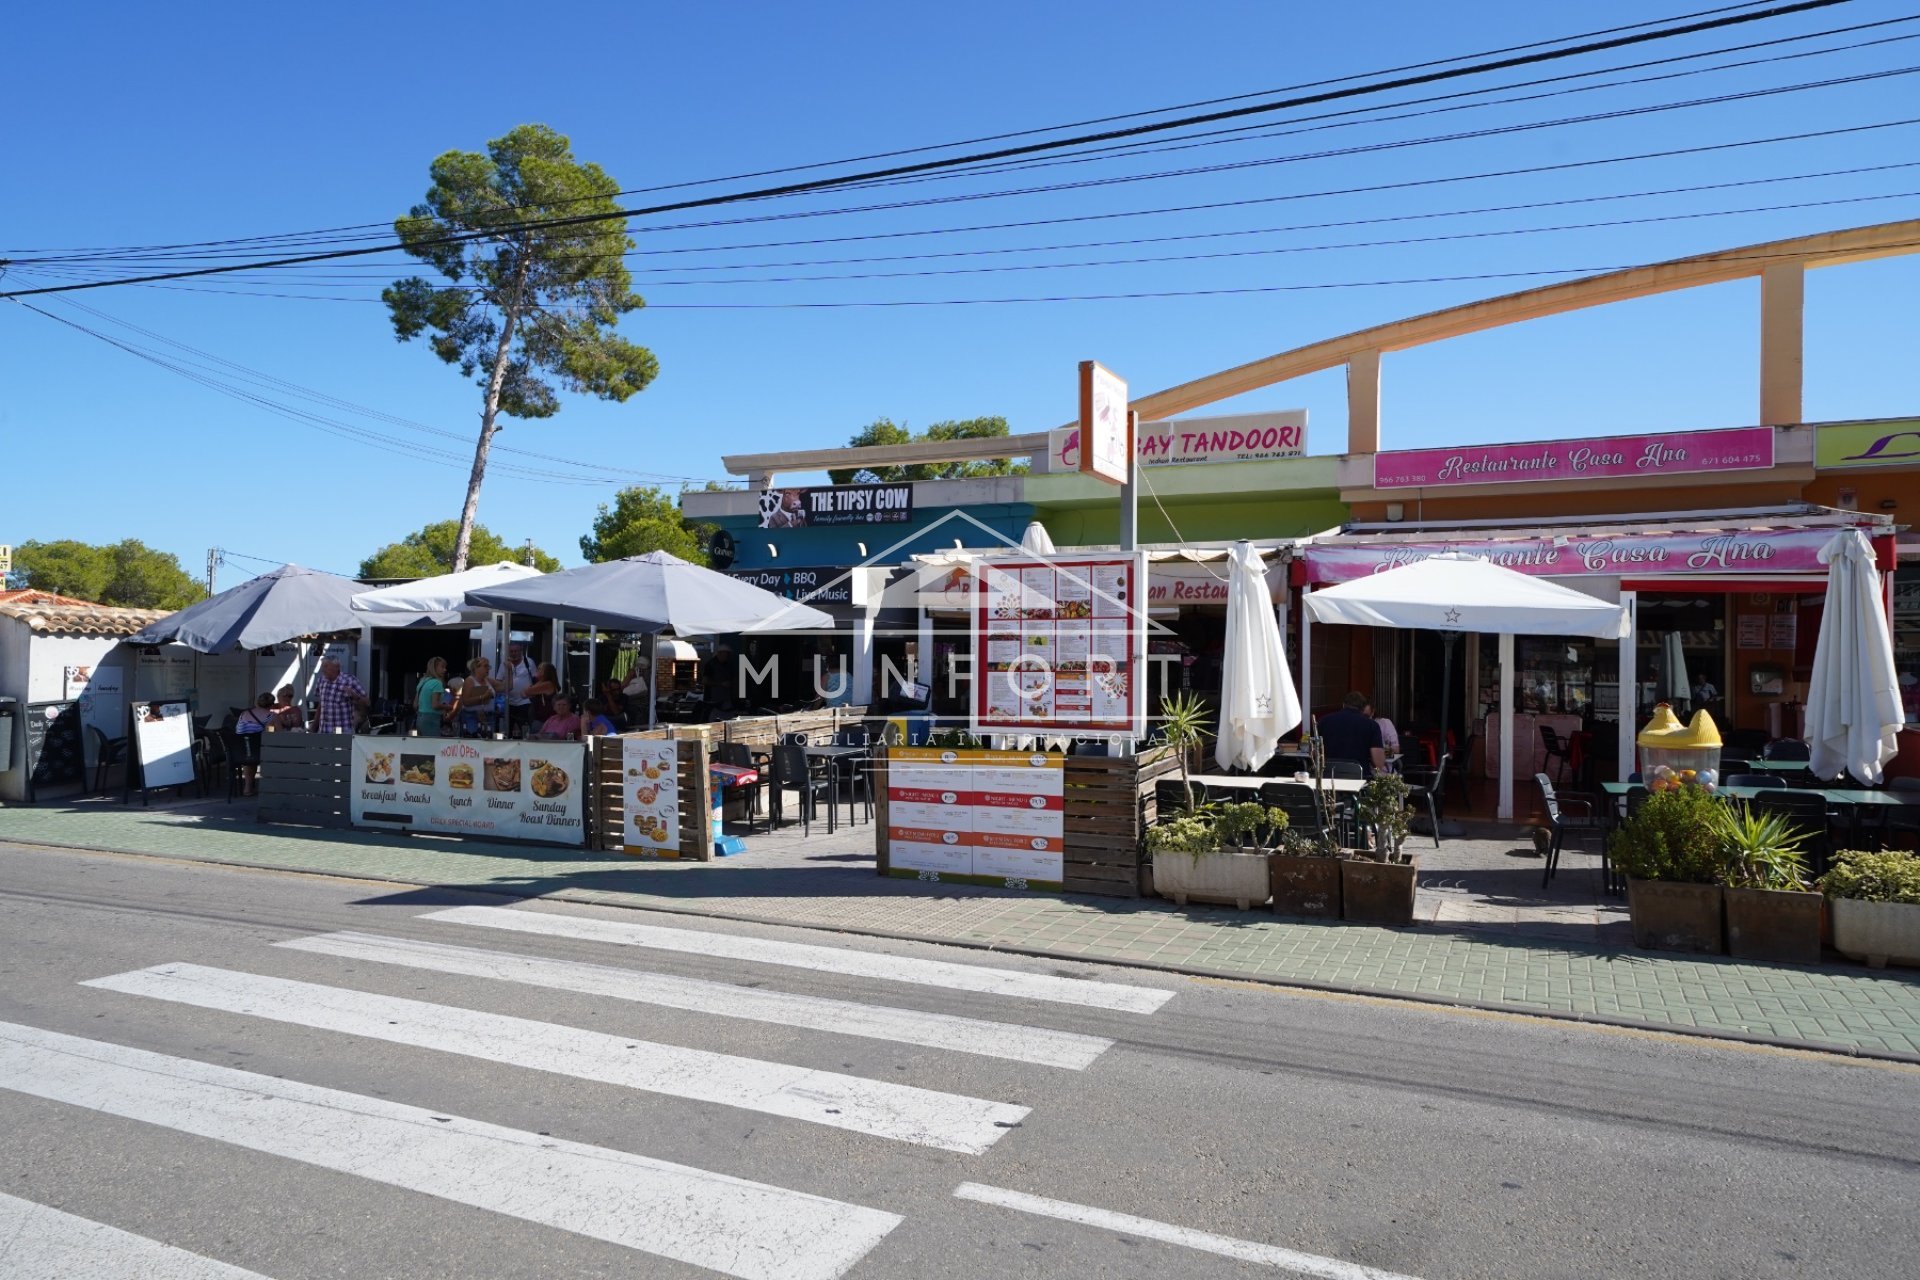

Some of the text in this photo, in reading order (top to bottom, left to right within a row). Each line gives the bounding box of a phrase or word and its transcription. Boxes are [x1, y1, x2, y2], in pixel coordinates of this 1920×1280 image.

[1181, 426, 1302, 453] TANDOORI
[1438, 442, 1687, 480] Restaurante Casa Ana
[1722, 455, 1740, 464] 604
[1743, 454, 1761, 463] 475
[811, 488, 909, 512] THE TIPSY COW
[1577, 540, 1669, 571] Casa
[1687, 535, 1775, 569] Ana
[761, 574, 780, 587] Day
[793, 573, 817, 587] BBQ
[796, 589, 816, 600] Live
[817, 588, 848, 600] Music
[441, 744, 480, 758] NOW OPEN
[361, 789, 515, 810] Breakfast Snacks Lunch Dinner
[533, 801, 567, 816] Sunday
[448, 818, 471, 828] SPECIAL
[519, 812, 580, 828] Roast Dinners
